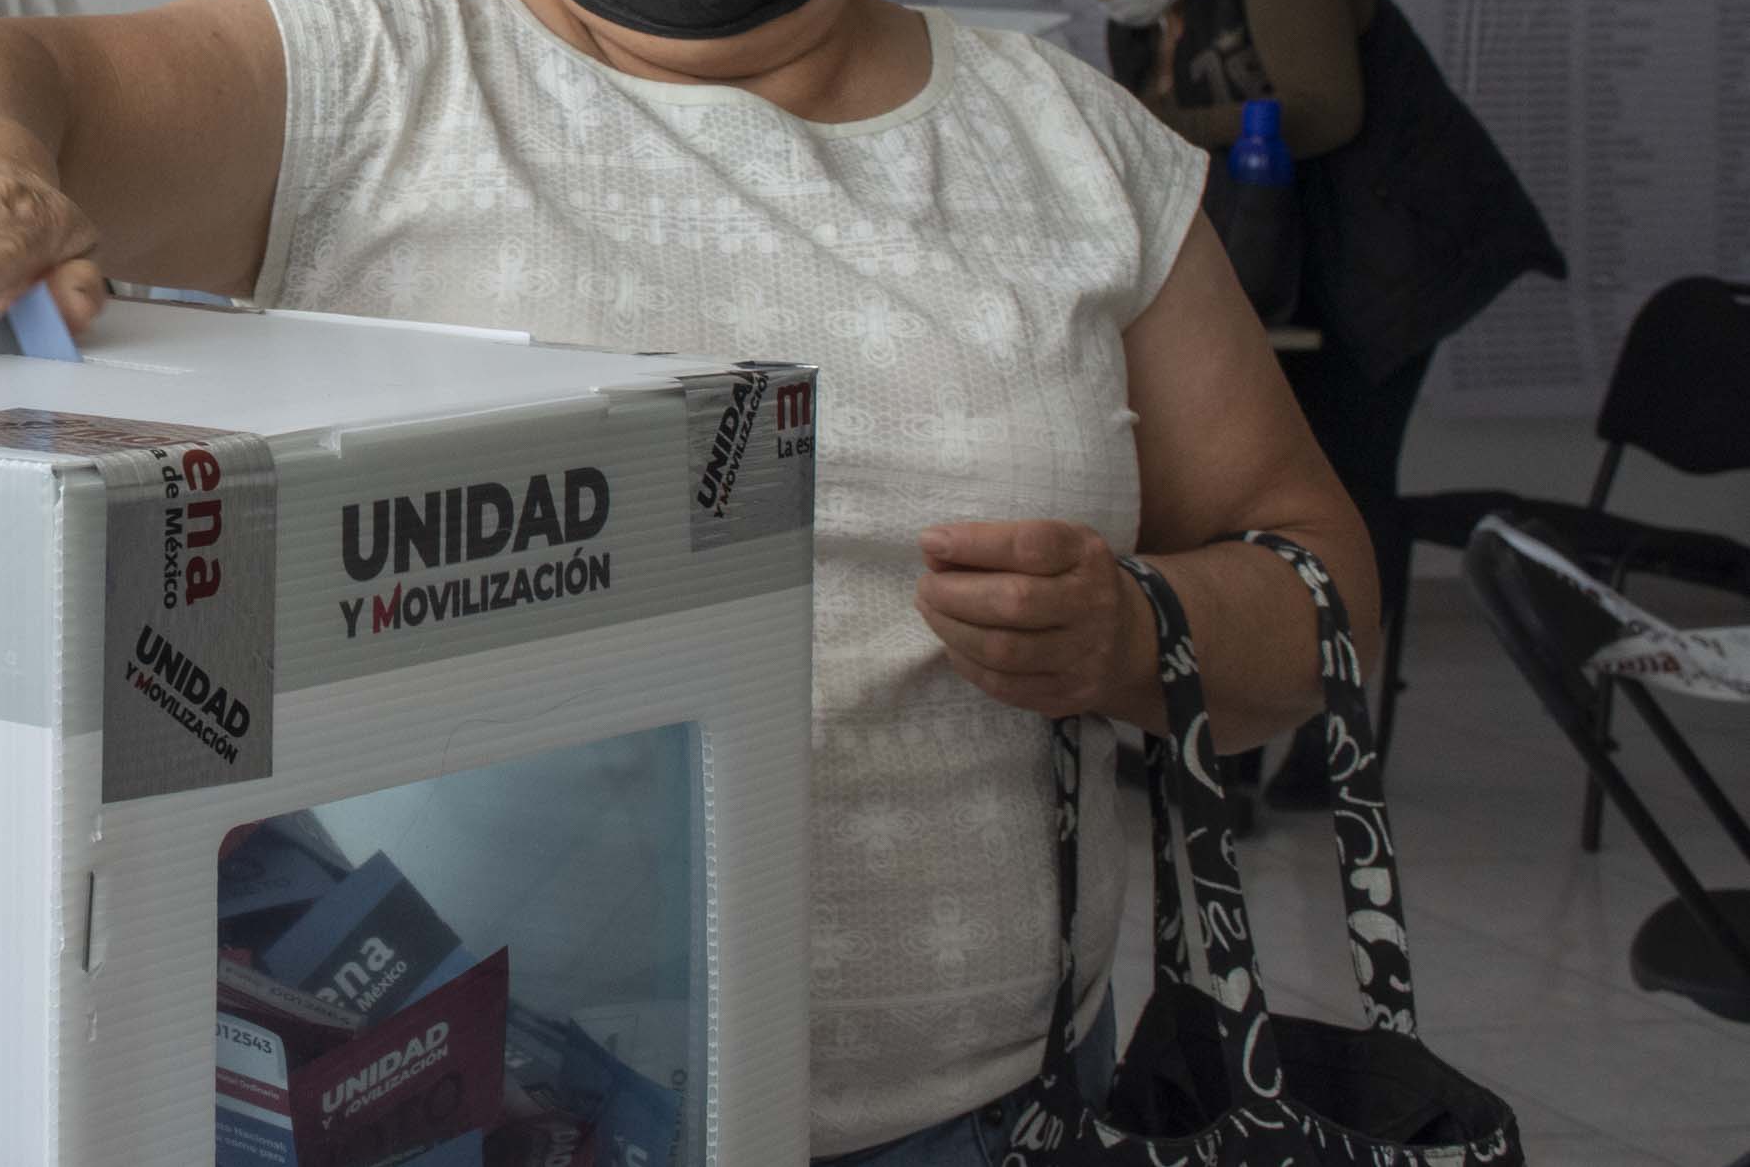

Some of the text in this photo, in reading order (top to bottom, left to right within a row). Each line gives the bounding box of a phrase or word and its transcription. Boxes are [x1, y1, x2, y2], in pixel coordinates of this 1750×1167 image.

[778, 436, 793, 459] La
[162, 465, 184, 610] de México
[341, 466, 611, 581] UNIDAD
[339, 546, 611, 638] Y MOVILIZACIÓN
[125, 661, 240, 766] Y MOVILIZACIÓN
[135, 625, 251, 739] UNIDAD
[356, 961, 408, 1012] México
[322, 1020, 451, 1114] UNIDAD
